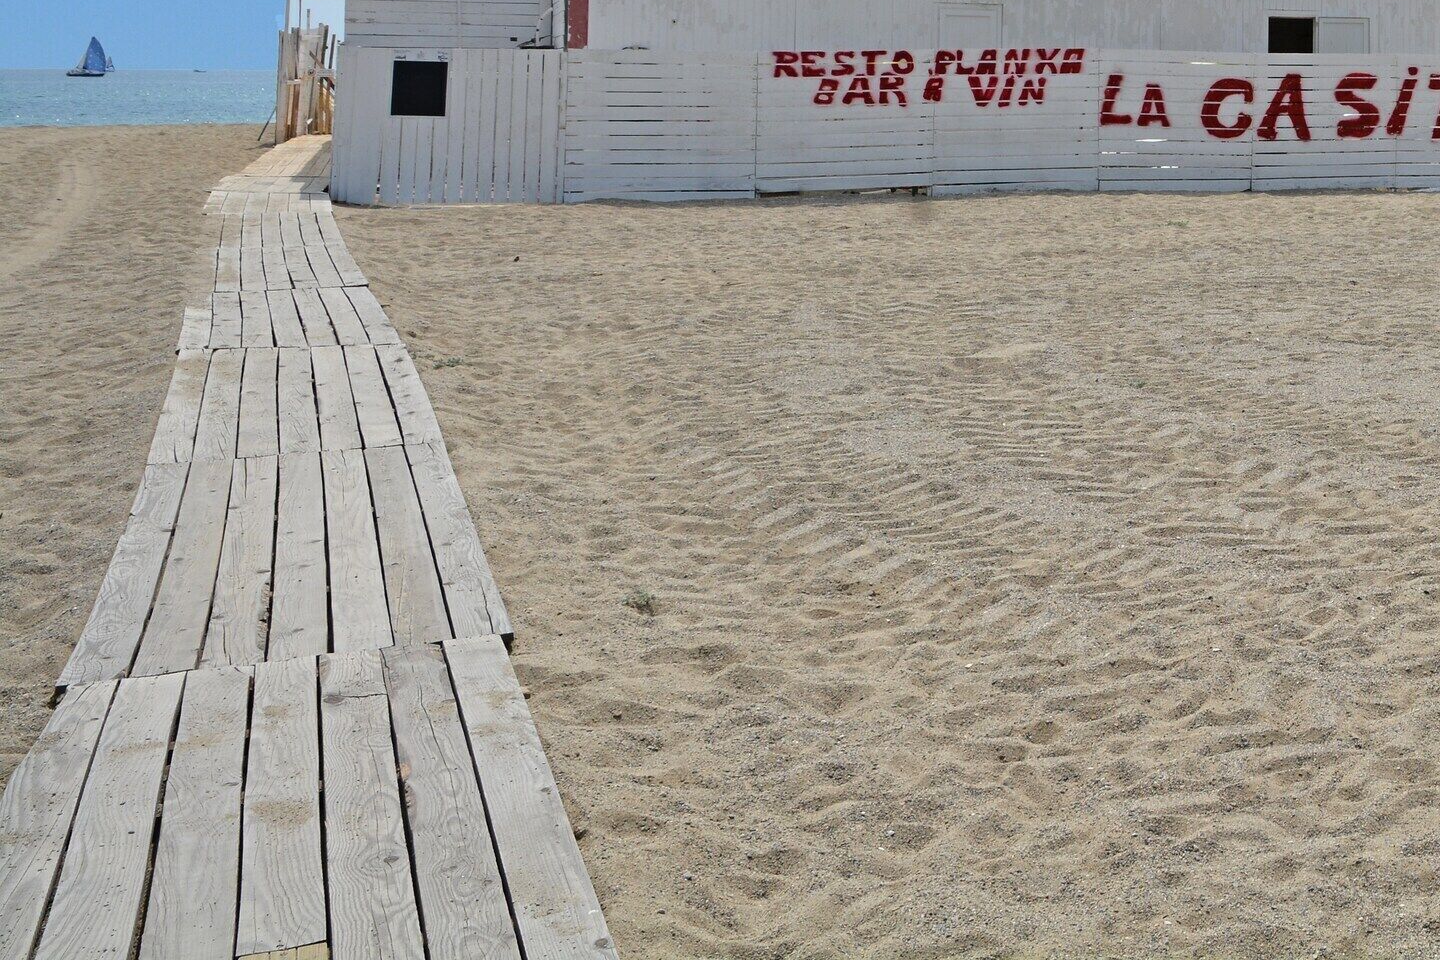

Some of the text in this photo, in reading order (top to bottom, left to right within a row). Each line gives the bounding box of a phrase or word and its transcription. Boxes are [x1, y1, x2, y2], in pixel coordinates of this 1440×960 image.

[772, 48, 1086, 77] RESTO PLANXA
[813, 72, 908, 107] BAR
[1099, 73, 1171, 127] LA
